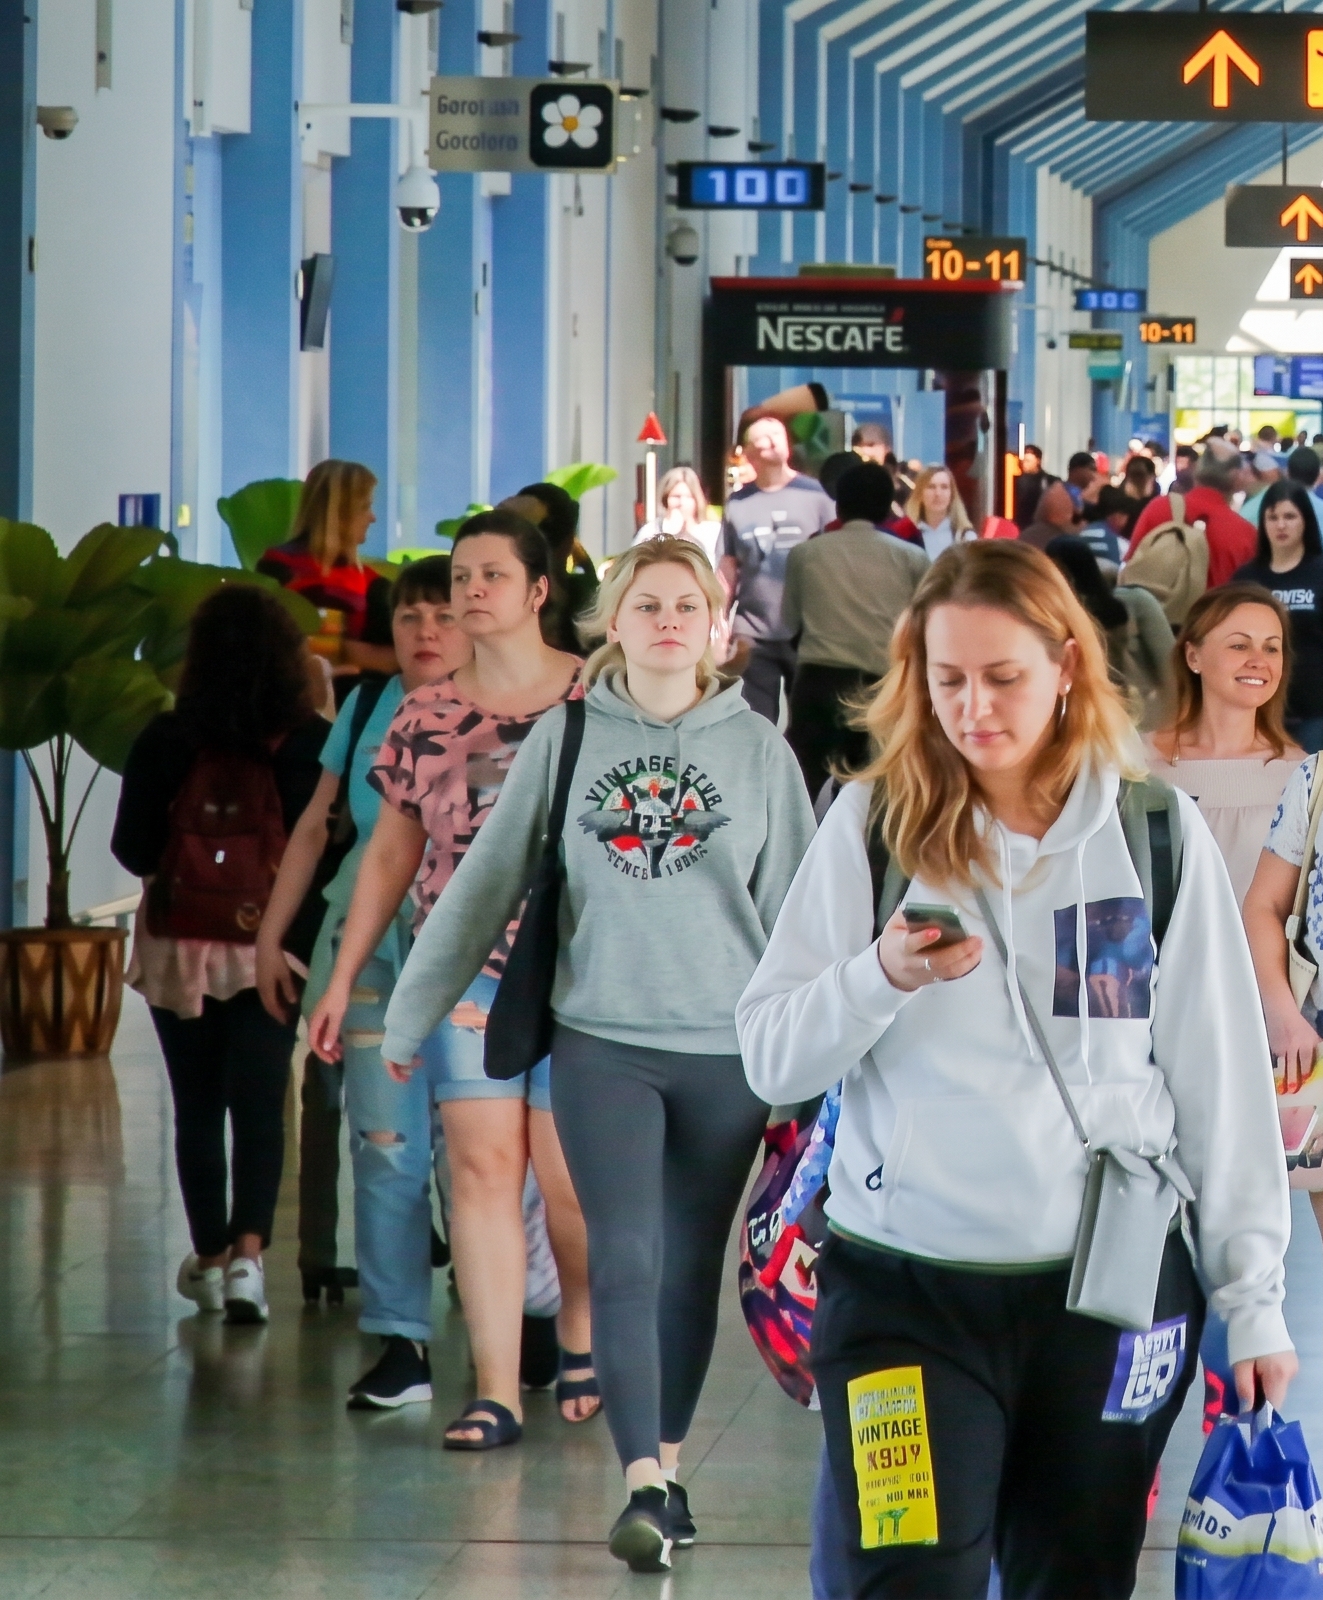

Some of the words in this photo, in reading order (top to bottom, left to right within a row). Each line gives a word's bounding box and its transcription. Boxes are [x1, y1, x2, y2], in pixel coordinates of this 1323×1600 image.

[709, 170, 806, 202] 100
[926, 249, 1019, 280] 10-11
[1139, 322, 1194, 343] 10-11
[857, 1417, 923, 1447] VINTAGE
